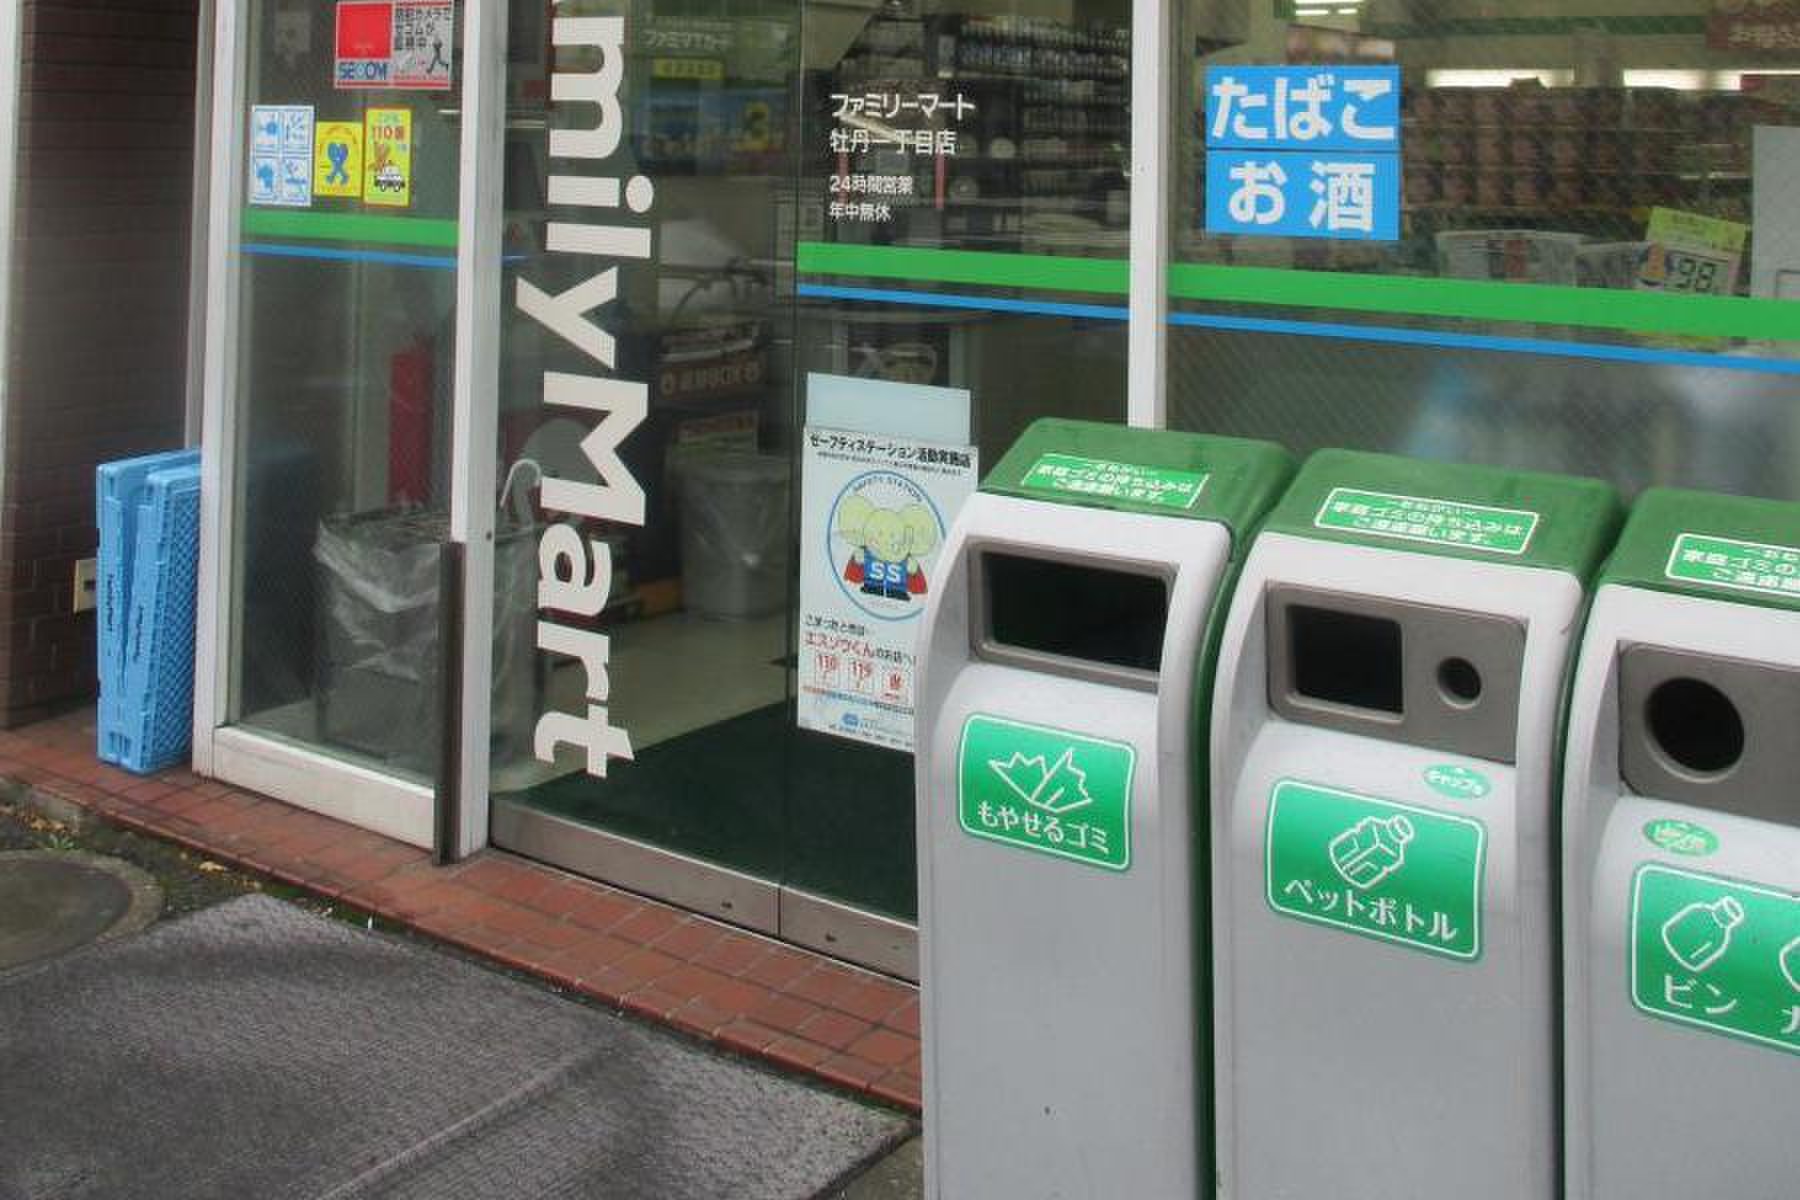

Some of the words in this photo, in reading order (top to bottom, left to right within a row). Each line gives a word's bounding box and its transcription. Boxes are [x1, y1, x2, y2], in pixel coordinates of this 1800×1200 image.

[339, 62, 388, 82] SECOM
[830, 93, 976, 120] ファミリーマート
[1212, 74, 1396, 141] たばこ
[828, 176, 914, 195] 24時間営業
[1227, 161, 1375, 233] お酒
[828, 203, 892, 222] 年中無休
[869, 561, 901, 582] SS
[977, 800, 1109, 855] もやせるゴミ
[1284, 879, 1458, 941] ペットボトル
[1664, 974, 1738, 1014] ビン
